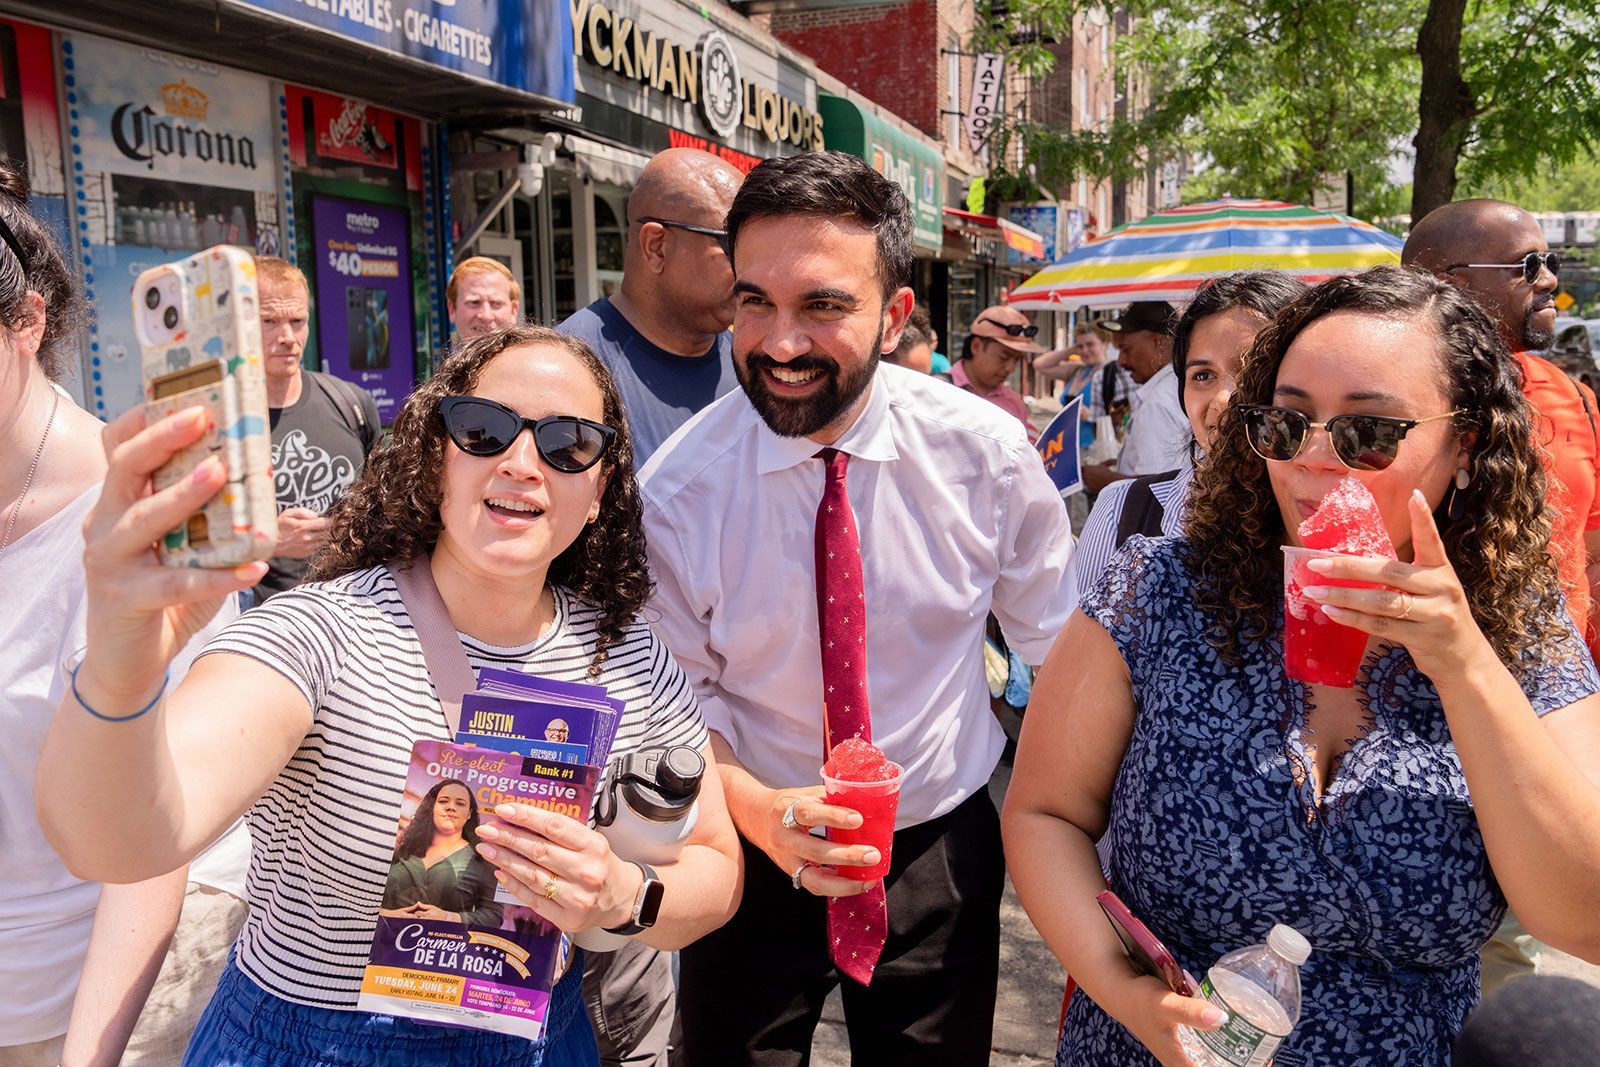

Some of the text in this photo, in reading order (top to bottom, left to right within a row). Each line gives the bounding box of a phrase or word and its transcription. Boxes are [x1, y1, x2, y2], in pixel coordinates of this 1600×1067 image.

[403, 8, 493, 66] CIGARETTES
[972, 56, 998, 140] TATTOOS
[743, 78, 825, 152] LIQUORS
[111, 102, 257, 170] Corona
[346, 213, 380, 229] metro
[328, 250, 362, 276] $40
[468, 710, 515, 733] JUSTIN
[440, 749, 510, 774] Re-elect
[534, 764, 574, 779] Rank #1
[426, 762, 577, 800] Our Progressive
[395, 923, 468, 953] Carmen
[413, 947, 437, 966] DE
[438, 952, 458, 969] LA
[462, 955, 503, 977] ROSA
[374, 975, 458, 995] TUESDAY, JUNE 24
[402, 971, 460, 985] DEMOCRATIC PRIMARY
[470, 984, 491, 993] PRIMARIA
[390, 987, 405, 995] EARLY
[466, 997, 478, 1005] VOTO
[504, 997, 512, 1005] DE
